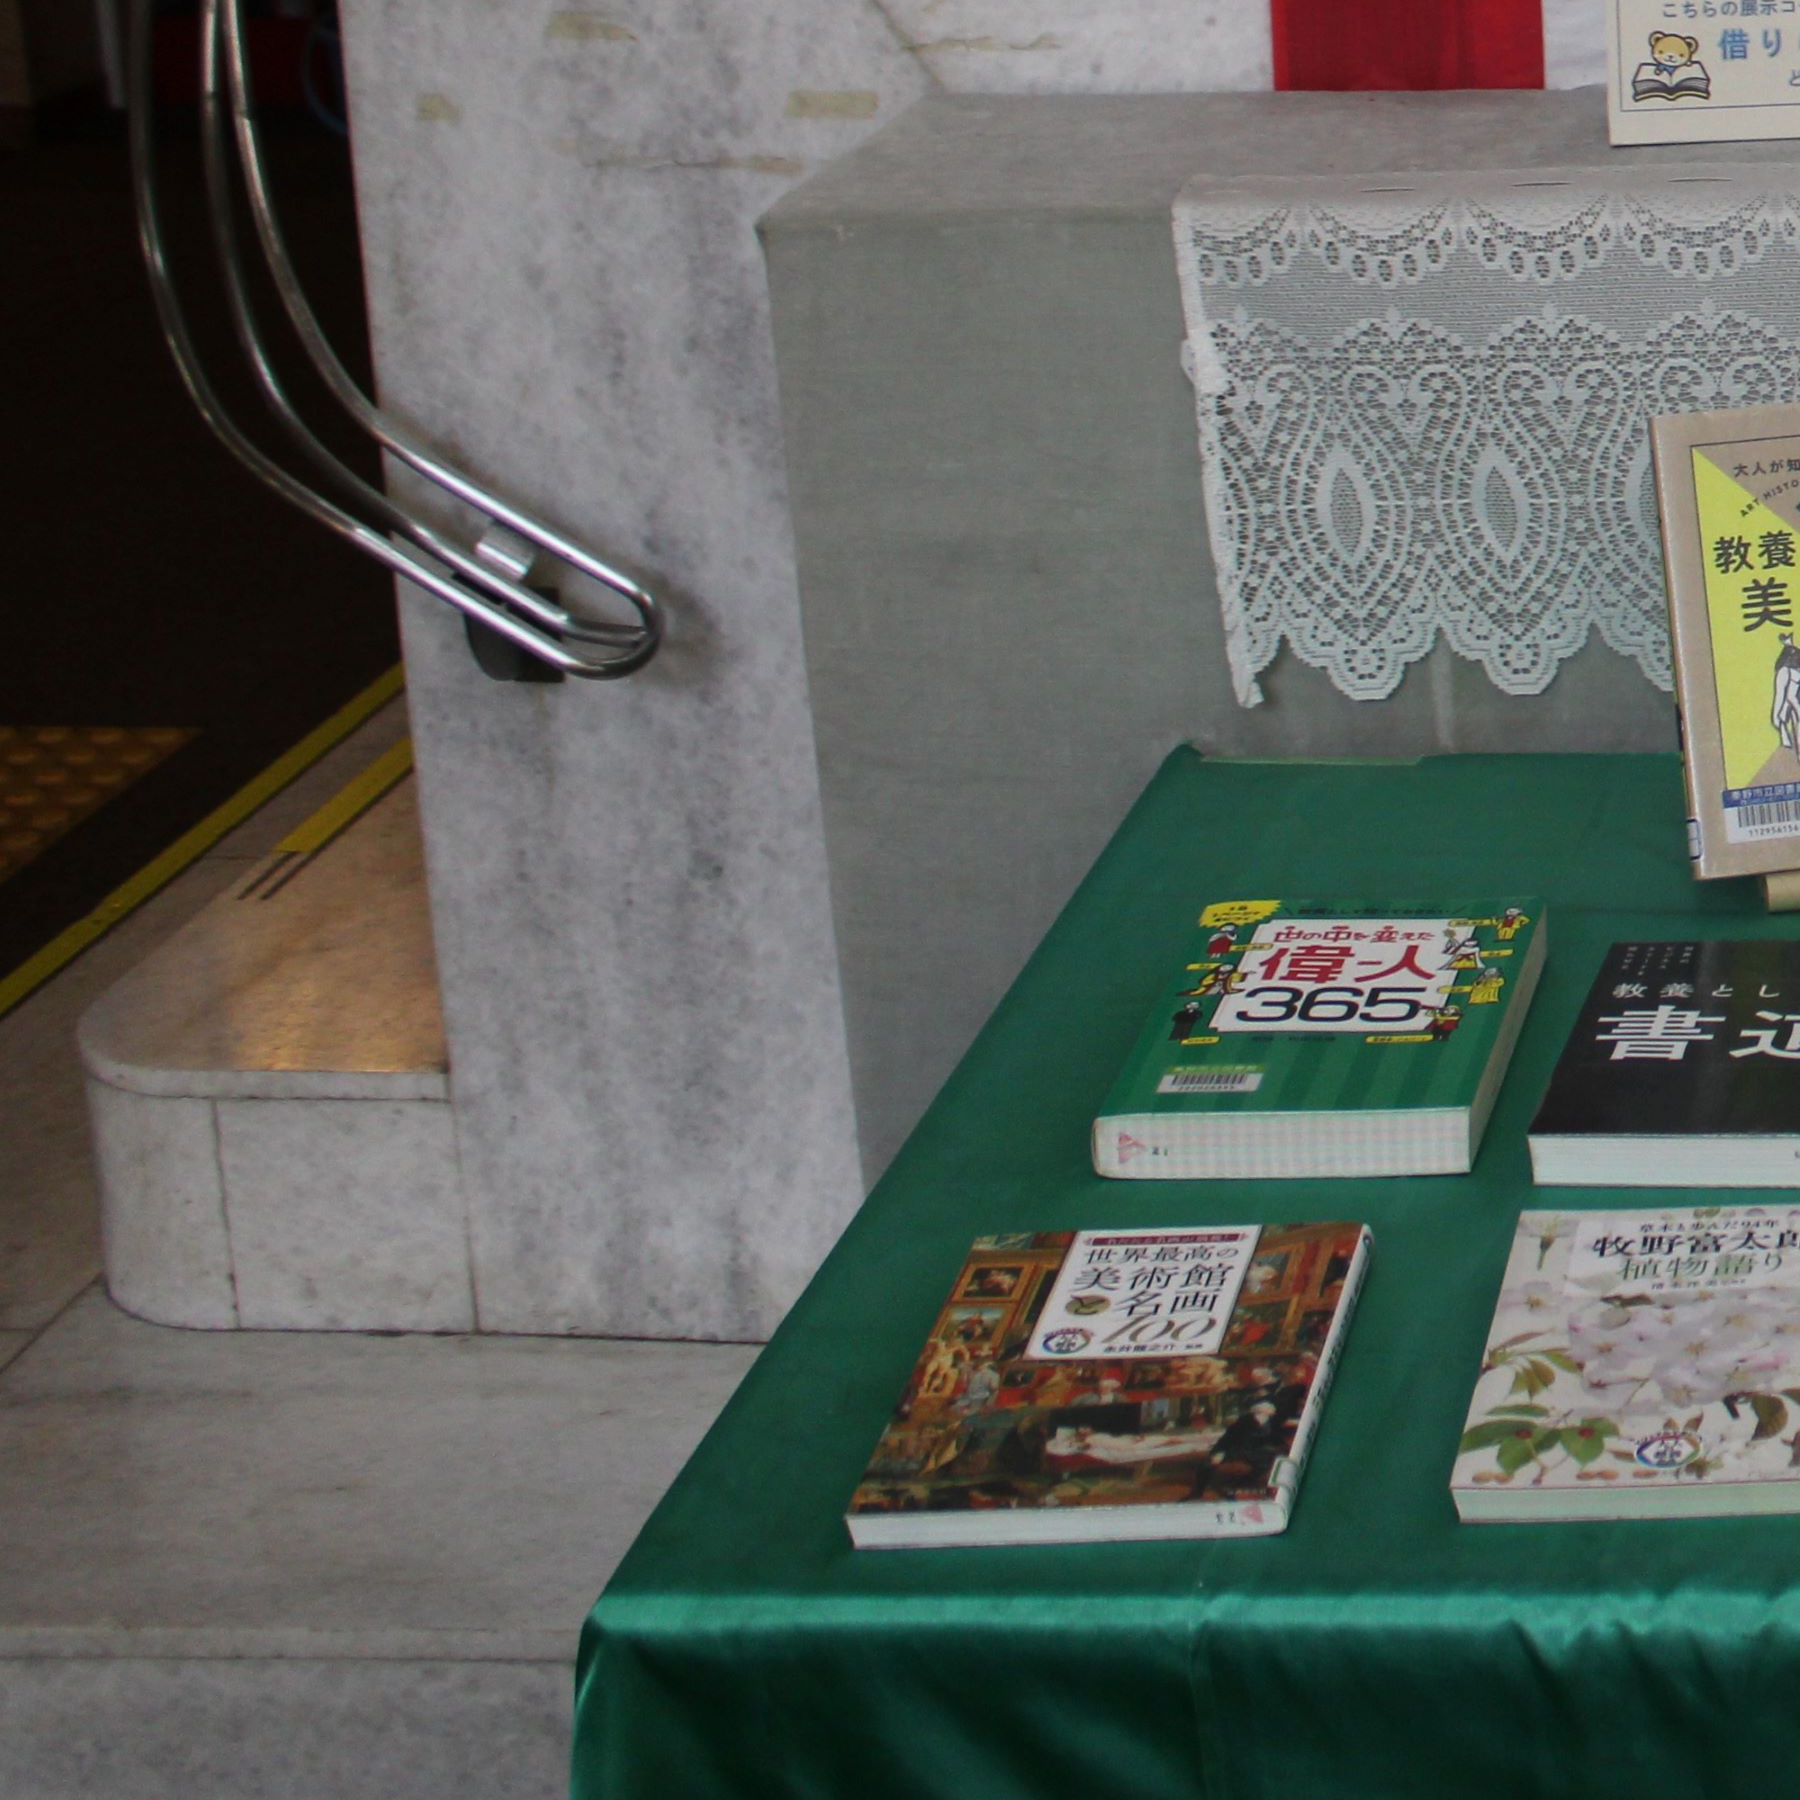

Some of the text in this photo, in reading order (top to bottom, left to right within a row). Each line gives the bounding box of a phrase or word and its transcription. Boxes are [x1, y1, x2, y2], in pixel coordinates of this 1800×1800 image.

[1739, 496, 1763, 519] ART
[1260, 944, 1437, 983] 偉人
[1236, 986, 1428, 1023] 365
[1084, 1246, 1239, 1265] 世界最高の
[1616, 1251, 1784, 1281] 植物語り
[1068, 1262, 1234, 1292] 美術館
[1101, 1313, 1217, 1344] 100
